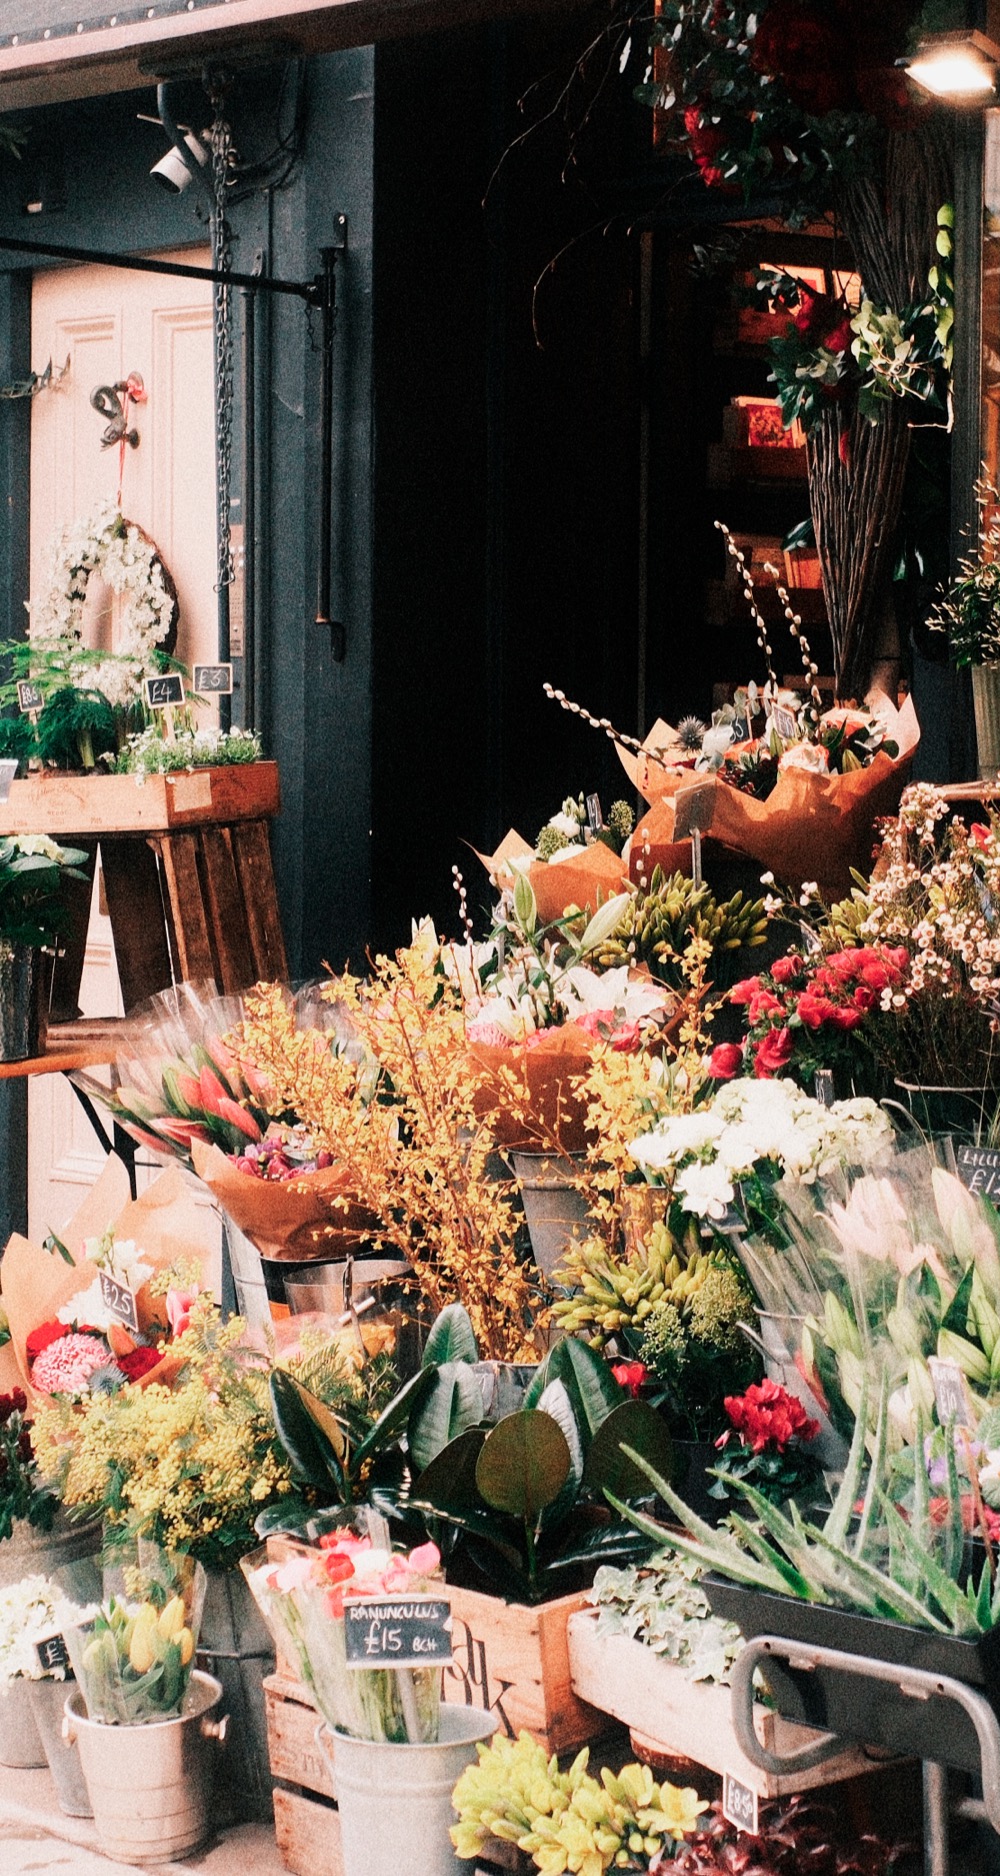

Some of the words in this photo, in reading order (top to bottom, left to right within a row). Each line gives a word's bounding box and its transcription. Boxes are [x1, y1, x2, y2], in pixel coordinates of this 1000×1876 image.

[152, 681, 172, 703] £4
[199, 670, 222, 690] £3
[103, 1278, 131, 1315] £25
[364, 1621, 402, 1654] £15
